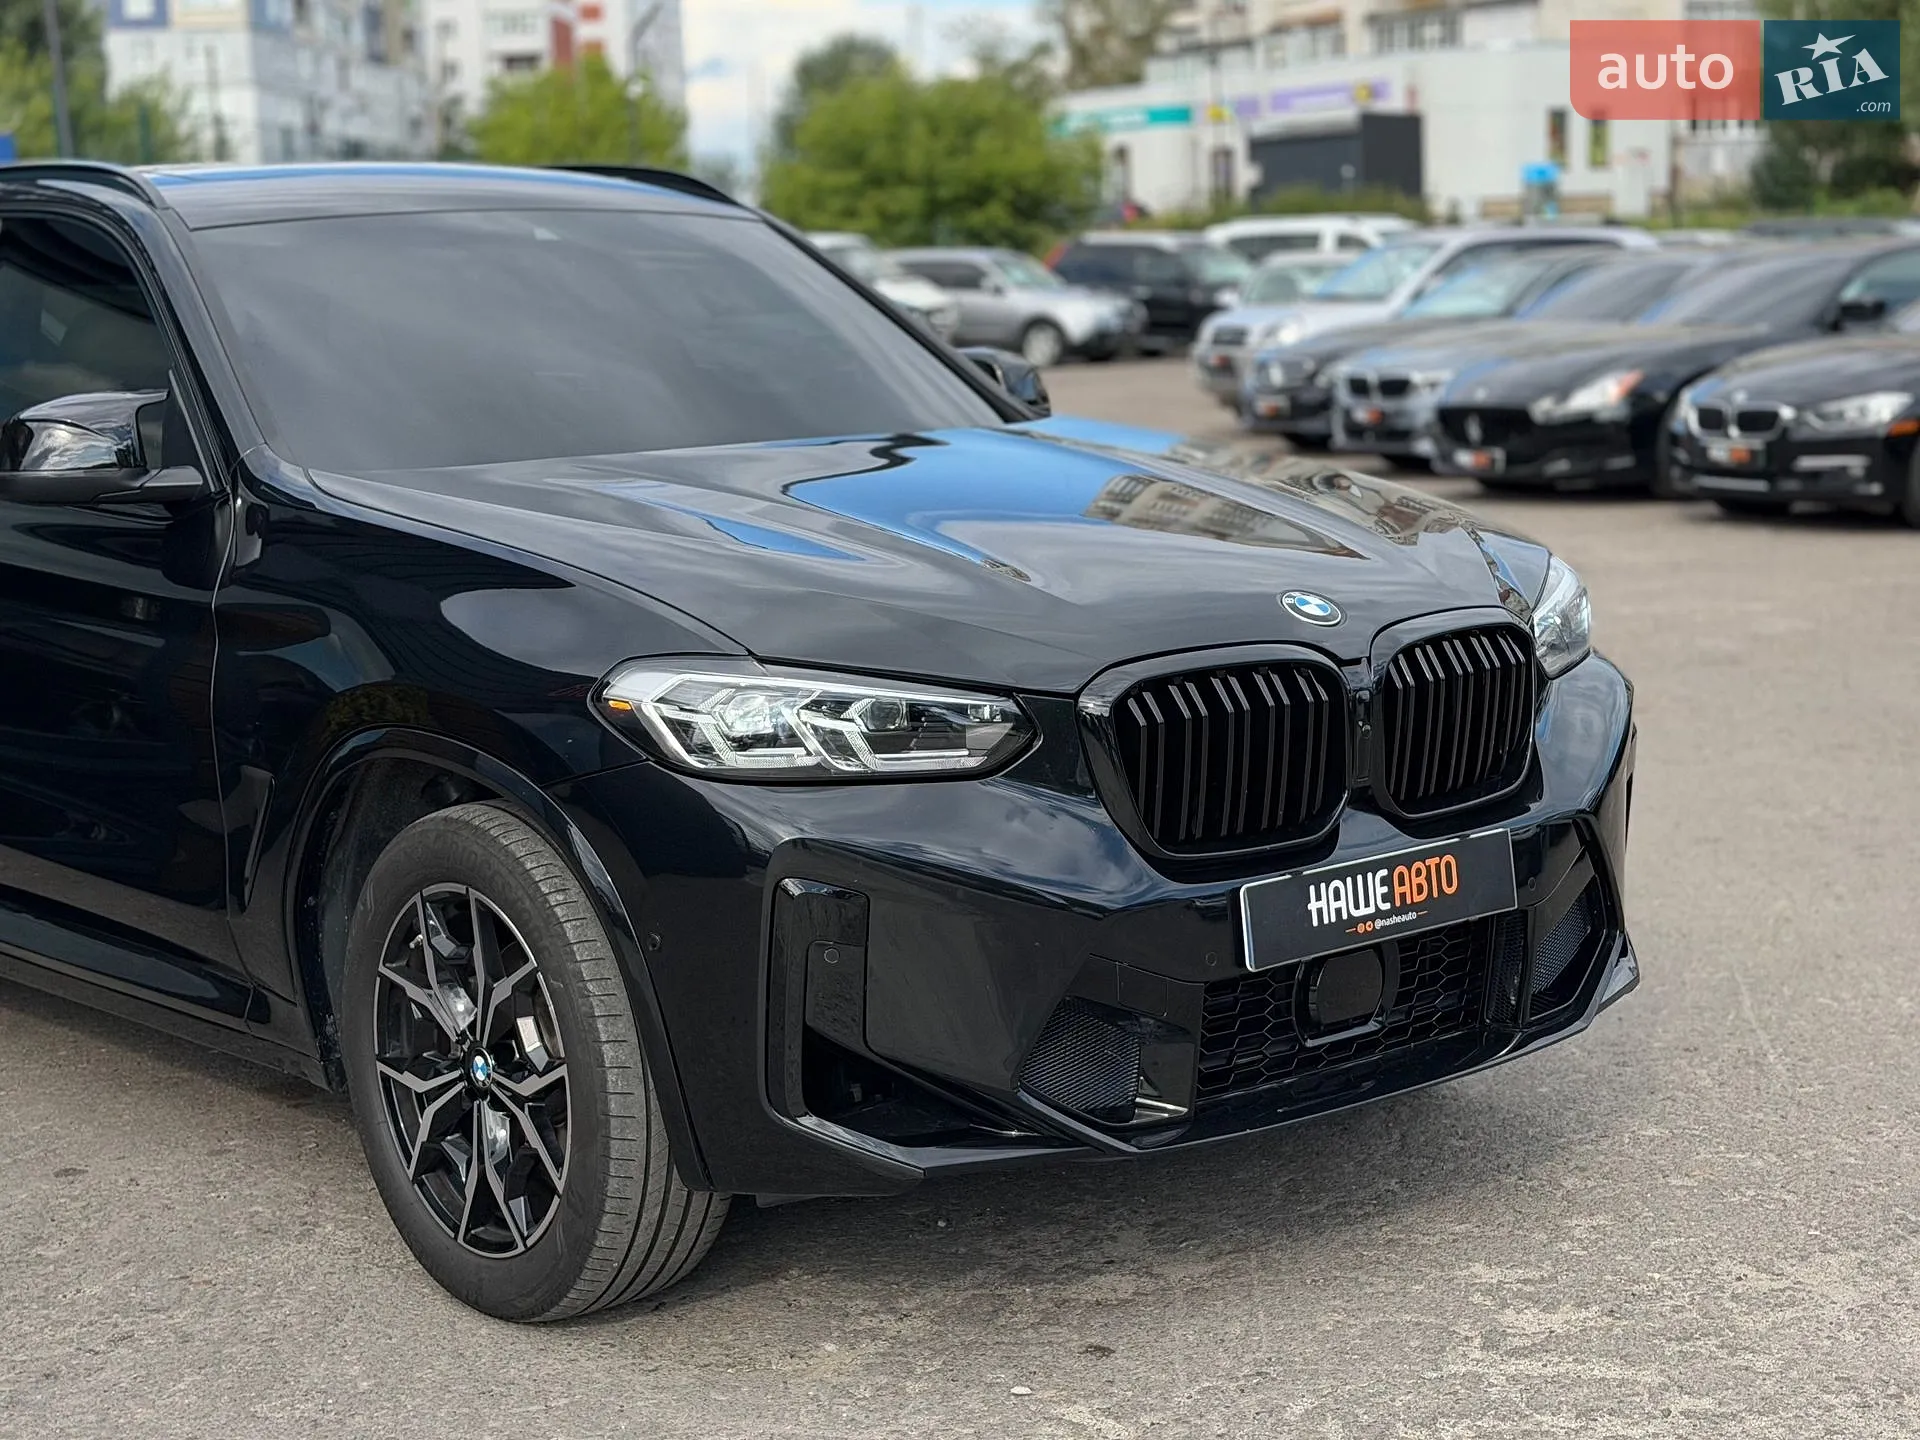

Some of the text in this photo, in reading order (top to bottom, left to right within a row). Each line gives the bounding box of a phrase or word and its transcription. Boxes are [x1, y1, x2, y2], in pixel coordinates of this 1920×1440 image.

[1307, 854, 1458, 927] НАШЕ АВТО
[1374, 911, 1417, 930] @nasheauto
